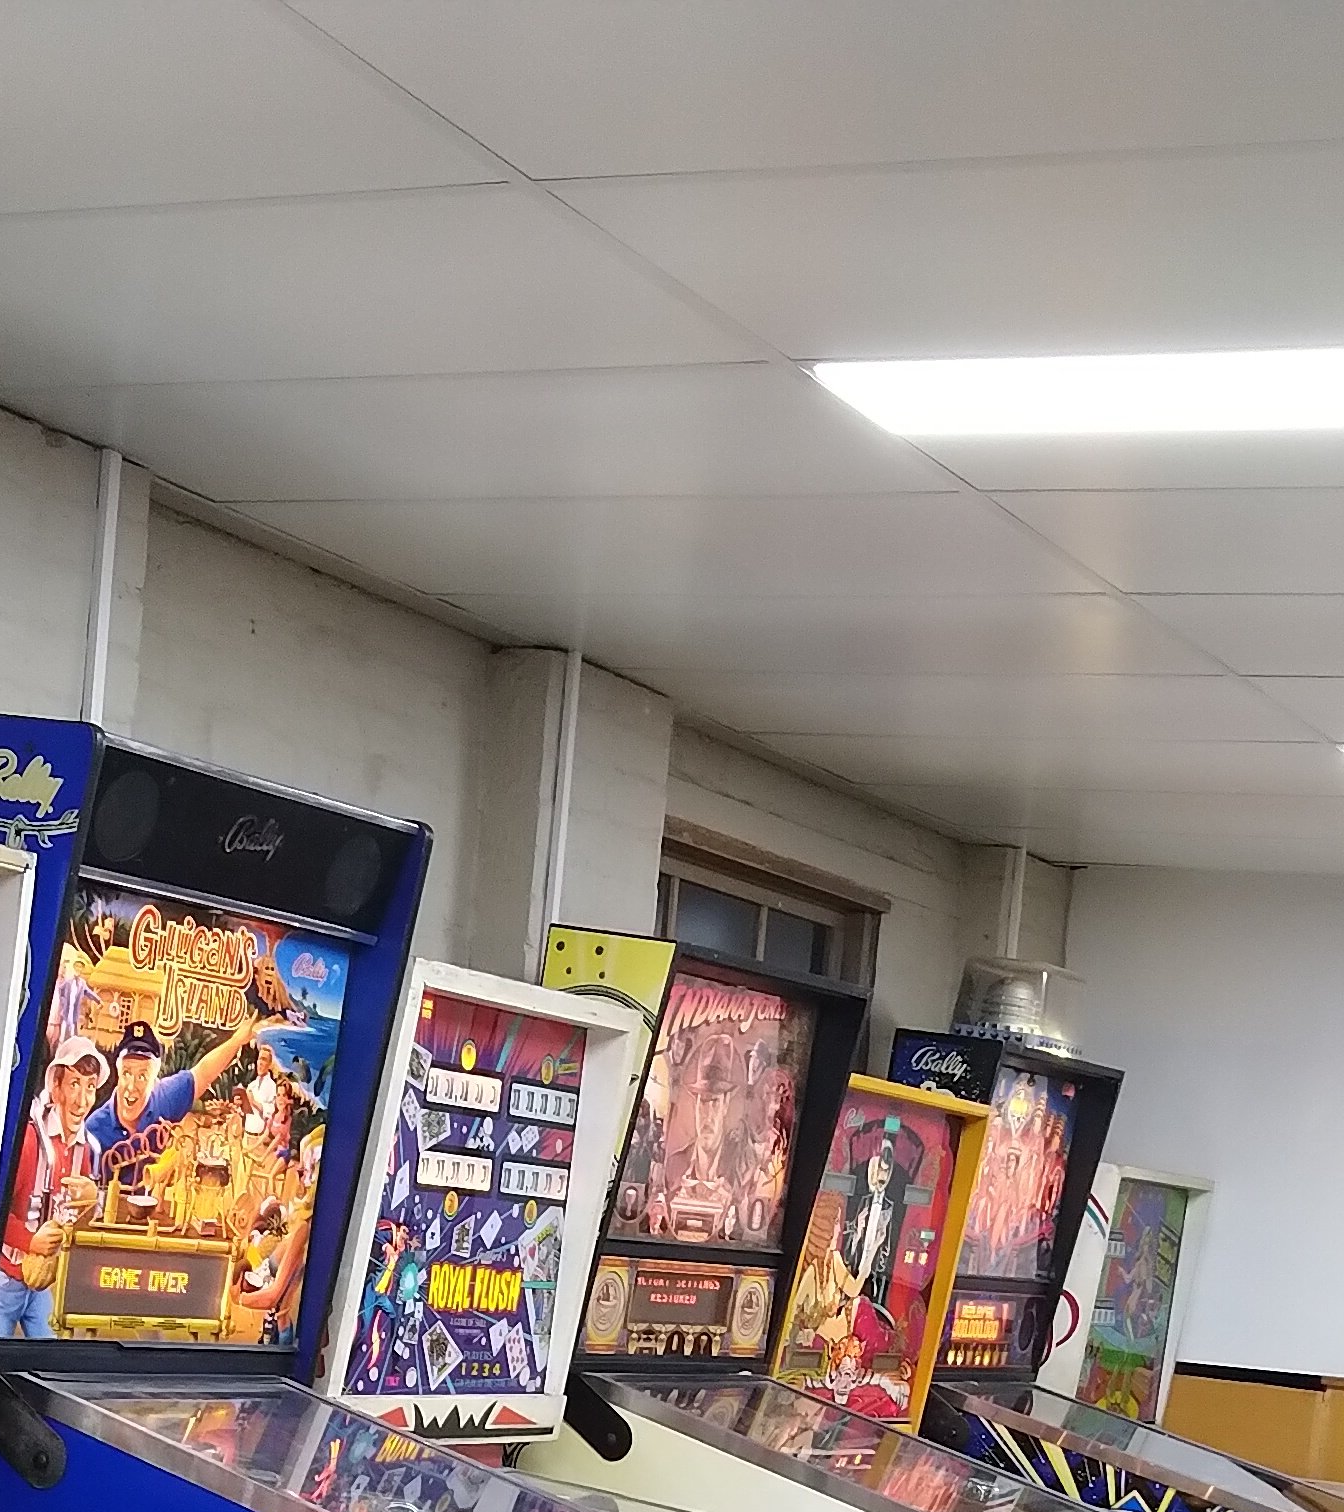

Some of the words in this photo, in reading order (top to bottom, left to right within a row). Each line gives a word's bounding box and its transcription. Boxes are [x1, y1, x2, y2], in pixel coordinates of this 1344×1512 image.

[224, 815, 285, 862] Bally
[654, 983, 749, 1050] INDIANA
[739, 996, 788, 1032] JONES
[911, 1046, 969, 1082] Bally
[99, 1266, 143, 1290] GAME
[148, 1269, 190, 1294] OVER
[428, 1263, 474, 1313] ROYAL
[473, 1266, 522, 1313] FLUSH
